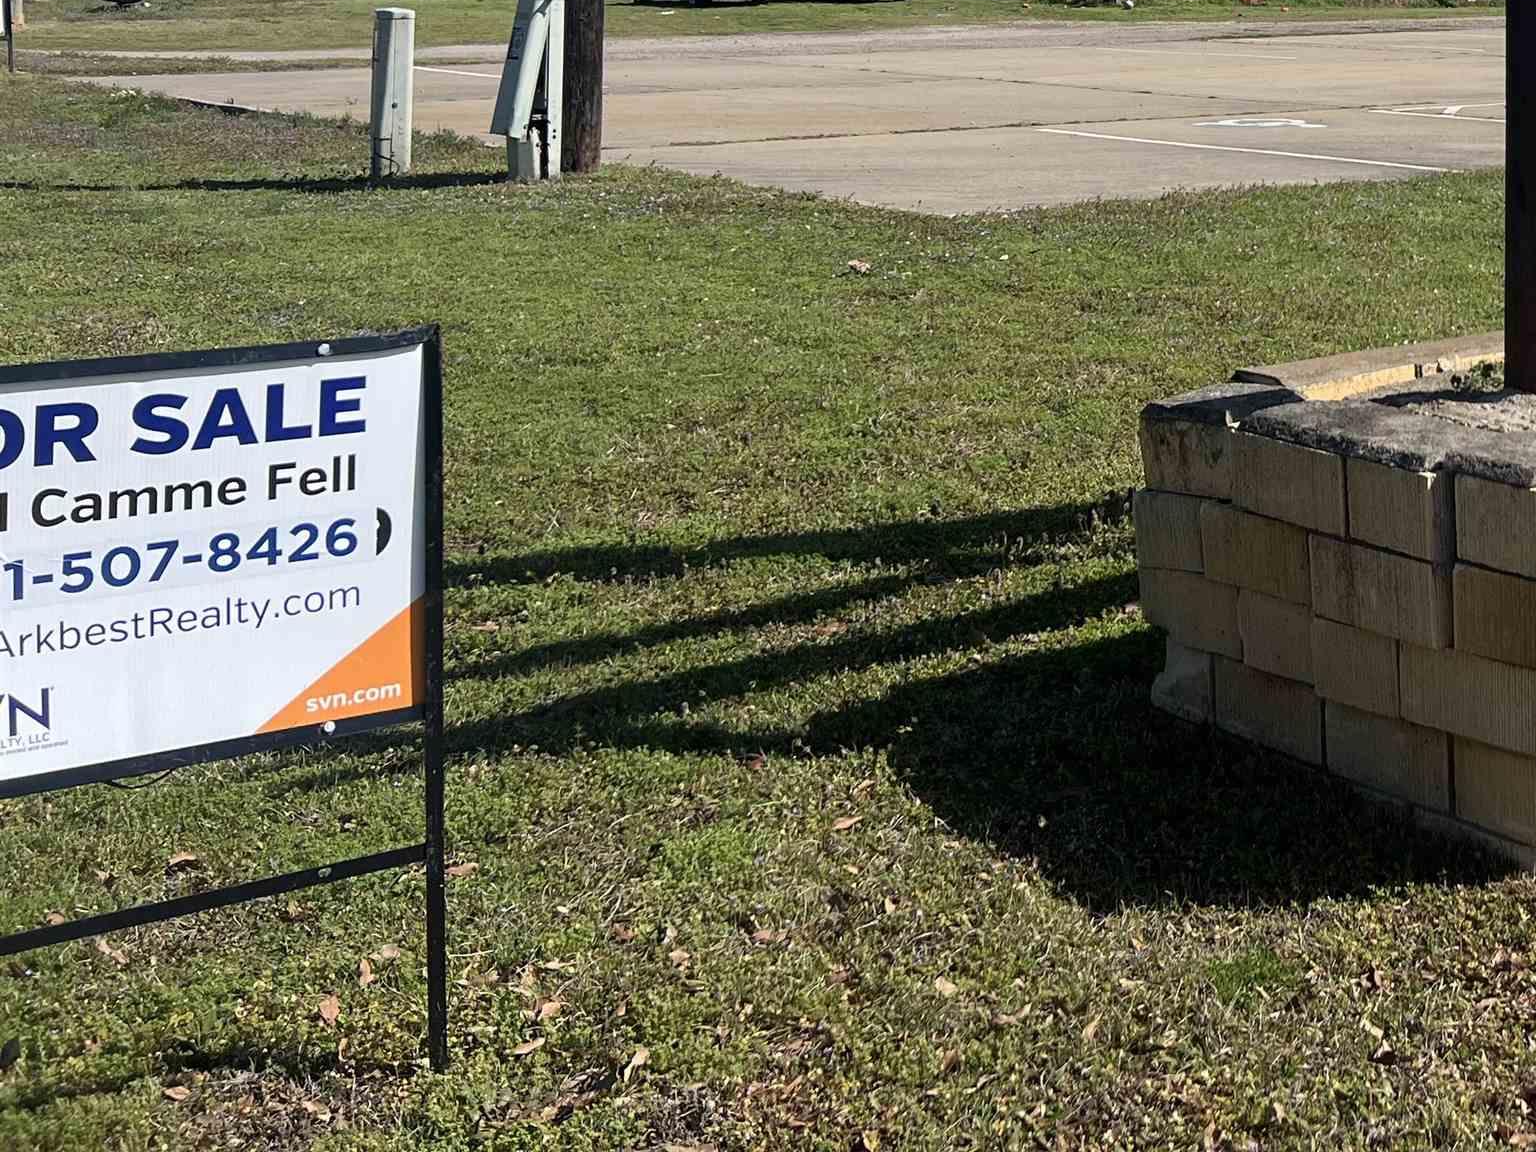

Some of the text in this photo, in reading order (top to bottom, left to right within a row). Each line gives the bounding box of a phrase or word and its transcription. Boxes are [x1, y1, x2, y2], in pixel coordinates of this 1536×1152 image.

[130, 376, 367, 455] SALE
[31, 476, 247, 528] Camme
[267, 453, 357, 500] Fell
[3, 517, 359, 601] 1-507-8426
[305, 682, 402, 713] svn.com
